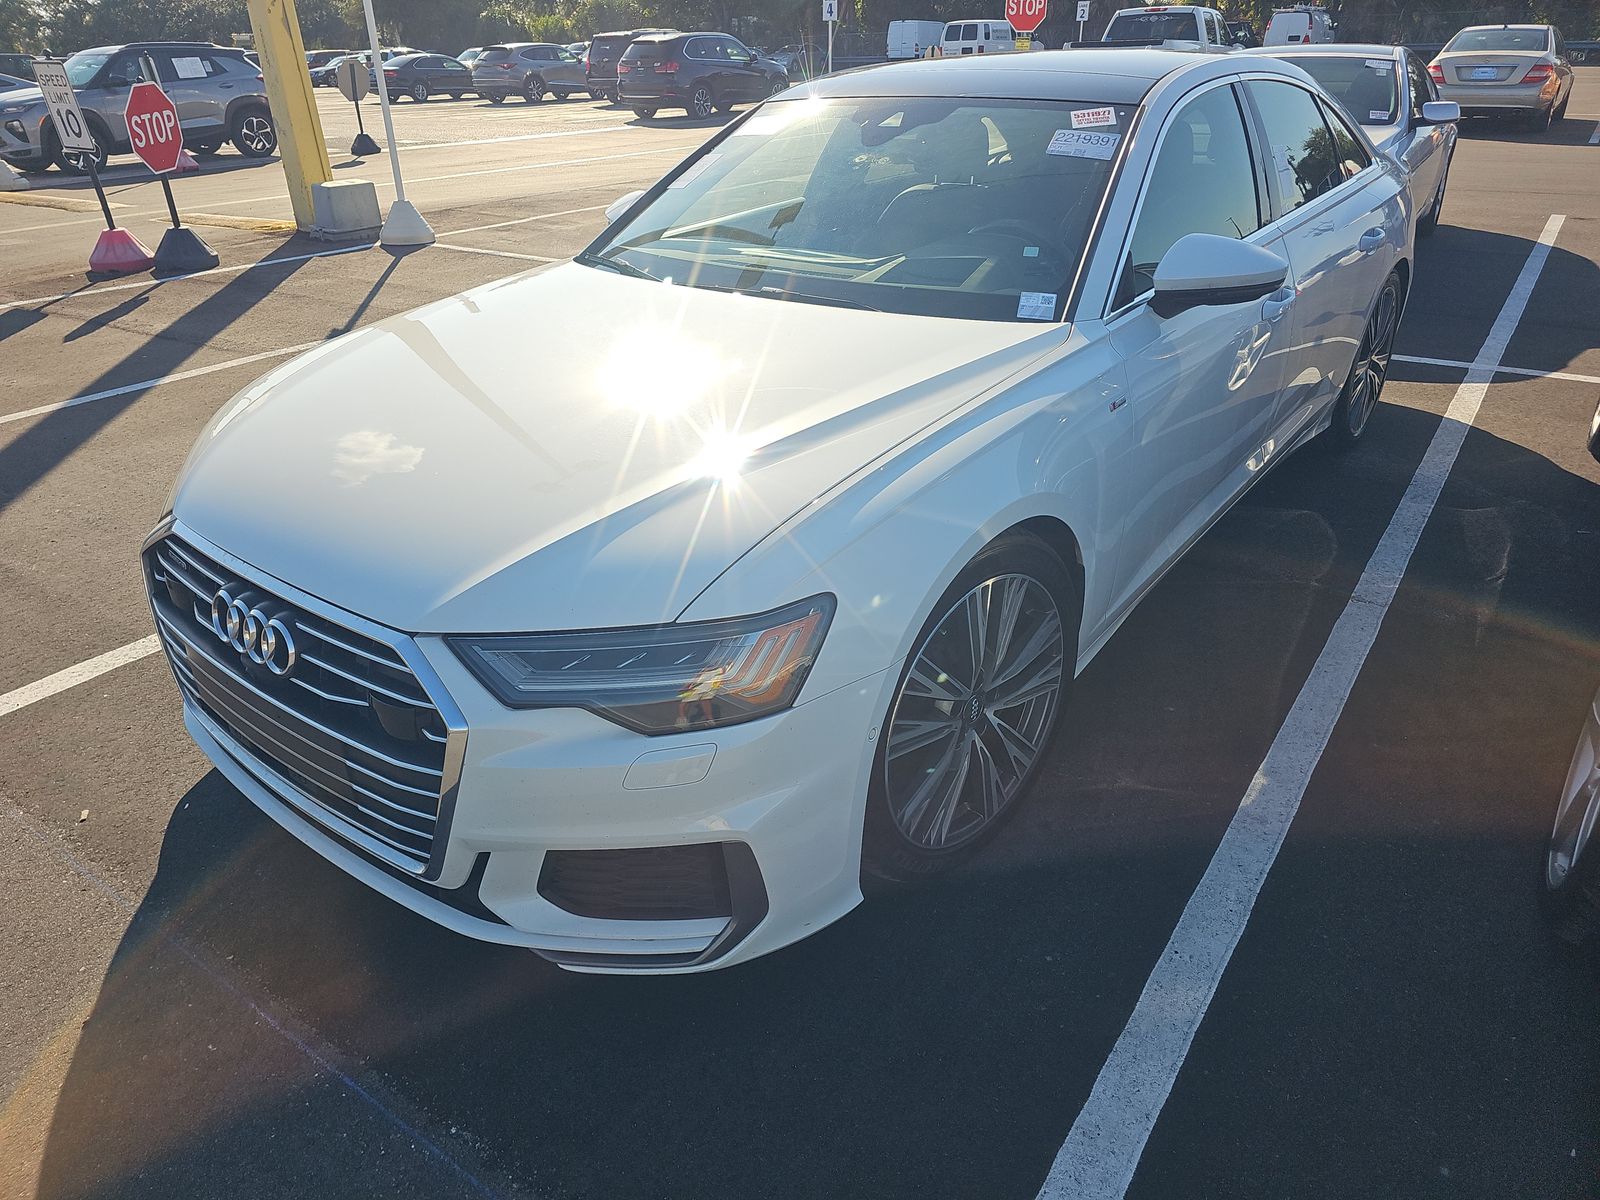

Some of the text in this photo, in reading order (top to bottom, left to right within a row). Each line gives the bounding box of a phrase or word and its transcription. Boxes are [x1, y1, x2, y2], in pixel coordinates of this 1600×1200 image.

[826, 3, 834, 17] 4
[1008, 0, 1045, 15] STOP
[1079, 8, 1086, 19] 2
[39, 73, 68, 87] SPEED
[48, 92, 72, 104] LIMIT
[56, 108, 82, 138] 10
[131, 109, 175, 148] STOP
[1054, 132, 1118, 147] 2219391
